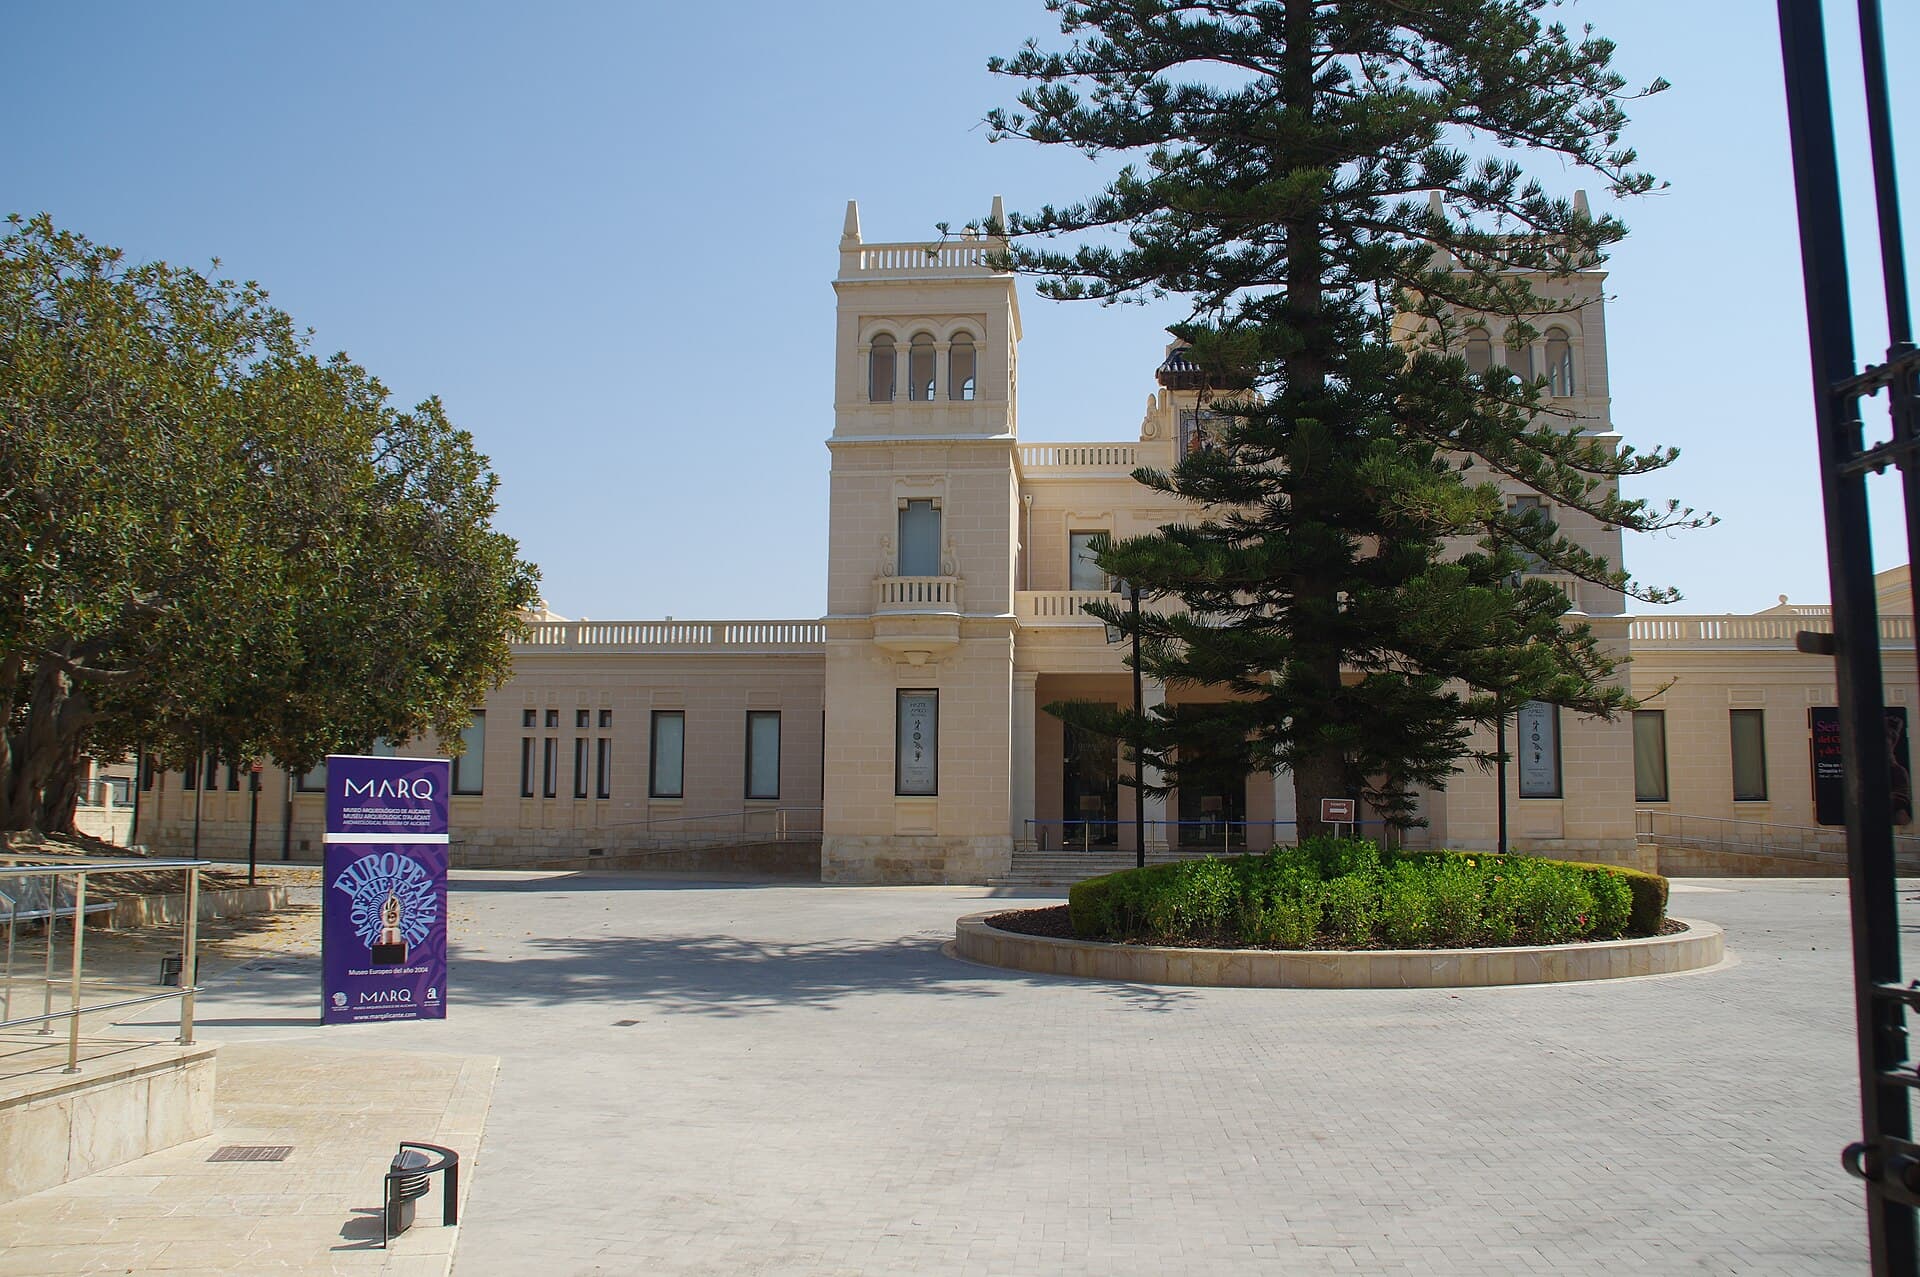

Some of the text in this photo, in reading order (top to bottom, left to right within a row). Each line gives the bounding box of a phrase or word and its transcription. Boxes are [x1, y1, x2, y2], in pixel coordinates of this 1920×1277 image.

[344, 778, 433, 801] MARQ
[332, 852, 438, 911] EUROPEAN
[350, 898, 369, 925] OF
[360, 877, 390, 902] THE
[390, 877, 419, 911] YEAR
[369, 968, 392, 976] Europeo
[360, 988, 411, 1004] MARQ
